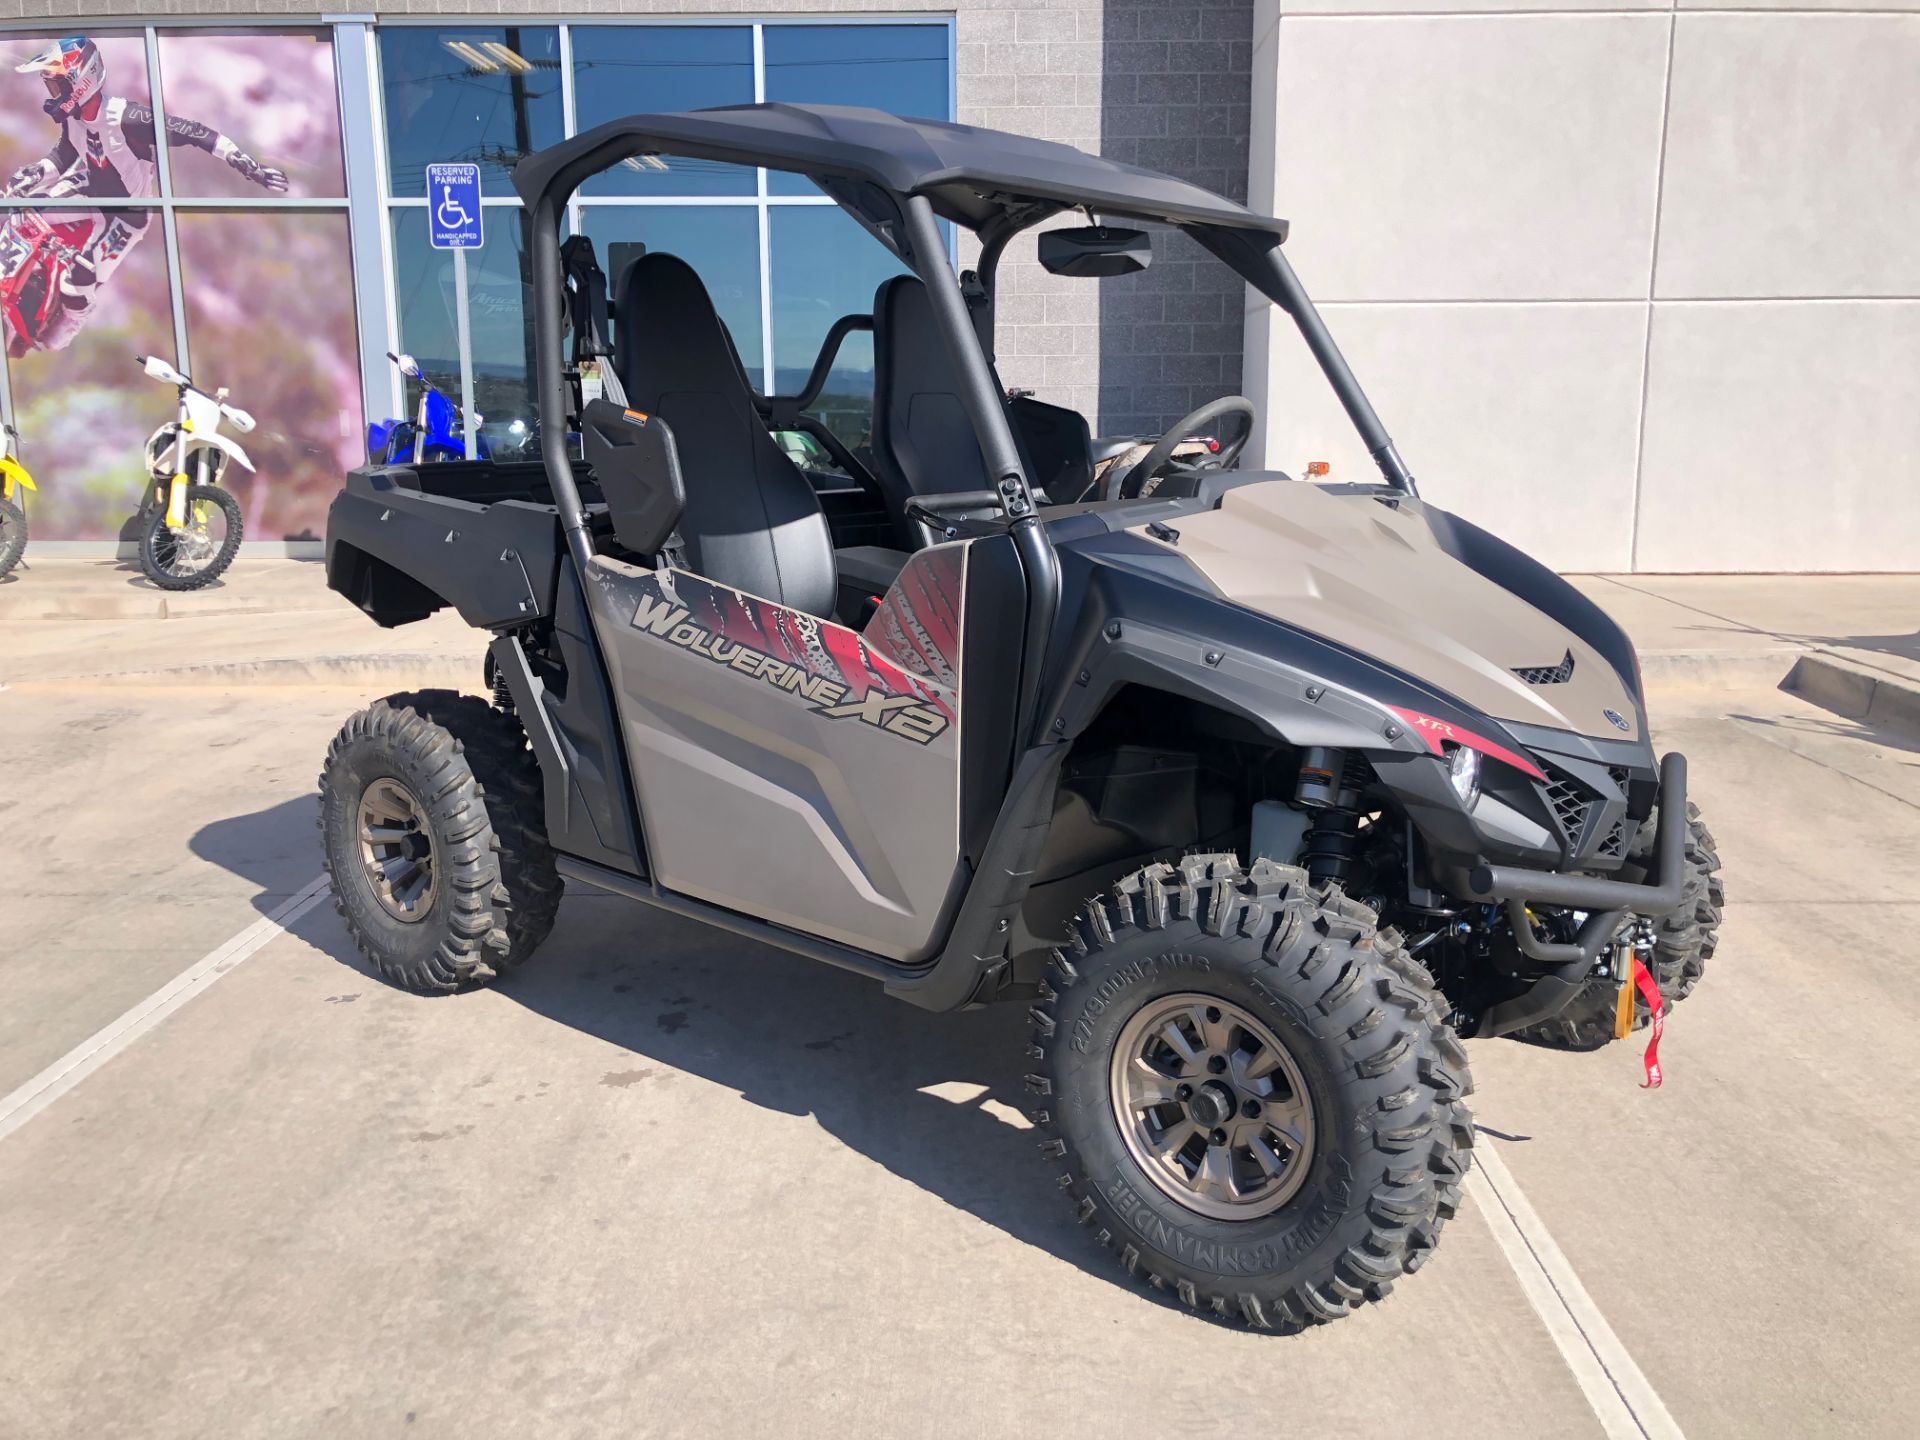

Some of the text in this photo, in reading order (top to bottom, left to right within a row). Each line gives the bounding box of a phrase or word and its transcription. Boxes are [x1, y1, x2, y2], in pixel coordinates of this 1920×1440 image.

[431, 166, 475, 176] RESERVED
[434, 175, 473, 185] PARKING
[436, 232, 477, 240] HANDICAPPED
[806, 685, 950, 746] X2
[1108, 1179, 1279, 1273] COMMANDER
